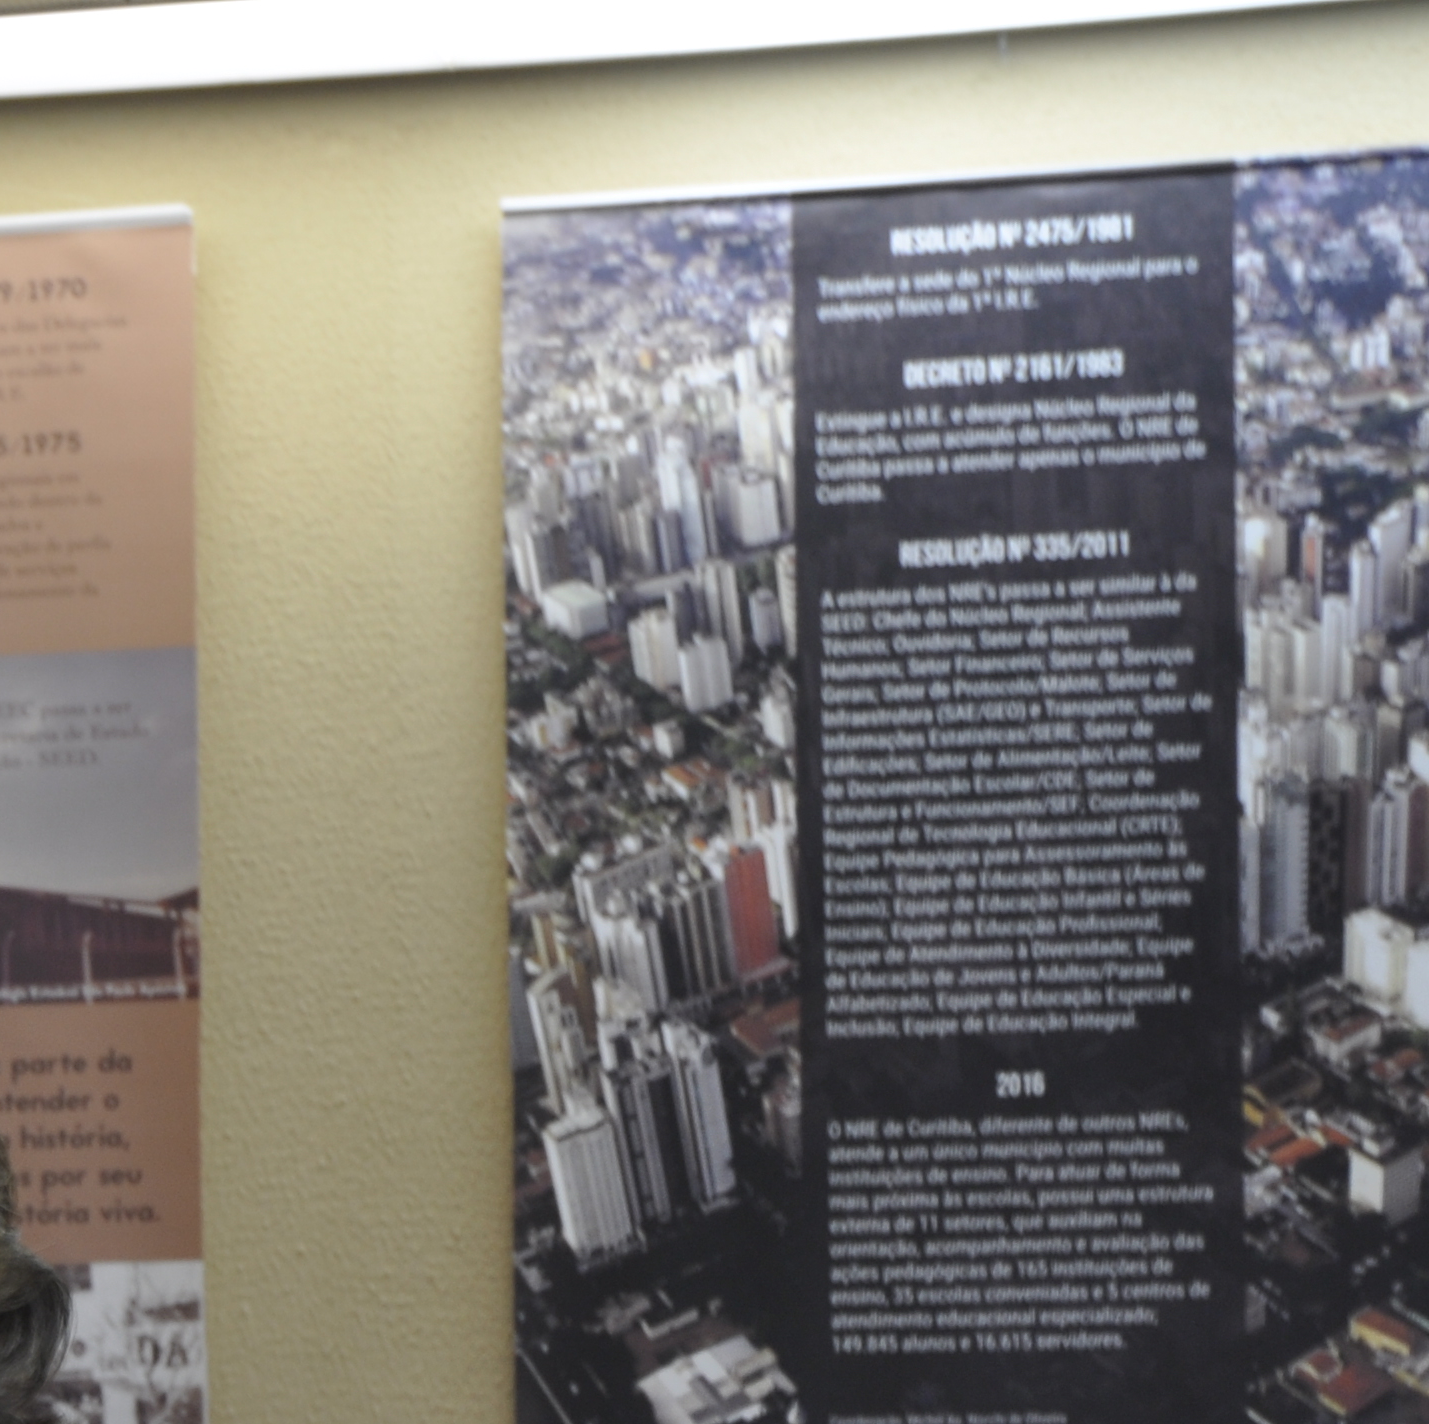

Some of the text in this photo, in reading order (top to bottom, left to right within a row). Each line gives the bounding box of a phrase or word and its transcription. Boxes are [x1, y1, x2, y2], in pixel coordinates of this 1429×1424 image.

[903, 357, 986, 389] DECRETO
[898, 535, 1004, 569] RESOLUÇÃO
[11, 1051, 87, 1084] parte
[98, 1048, 133, 1073] da
[42, 1170, 86, 1196] por
[100, 1169, 142, 1186] seu
